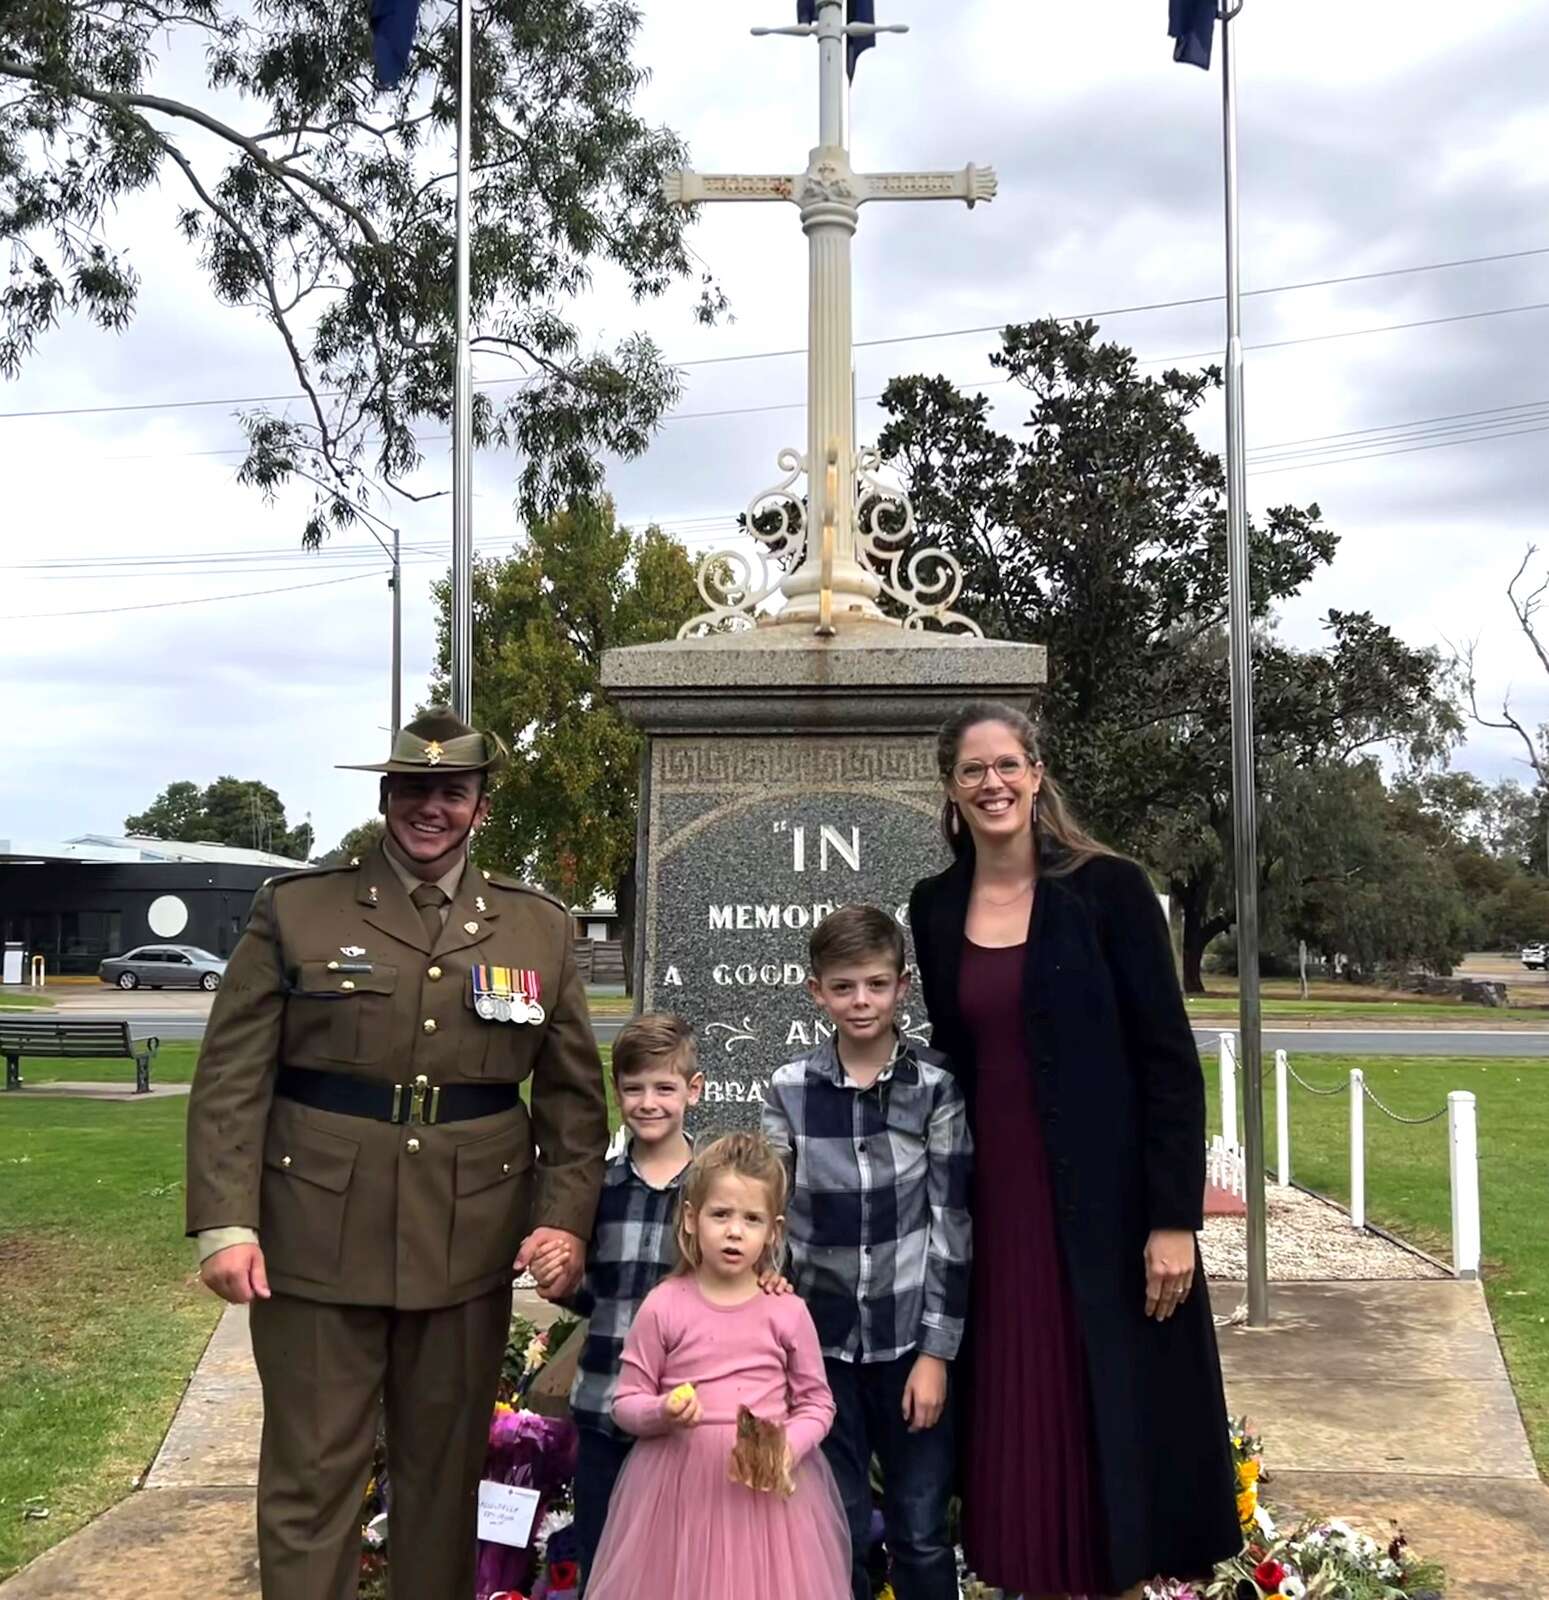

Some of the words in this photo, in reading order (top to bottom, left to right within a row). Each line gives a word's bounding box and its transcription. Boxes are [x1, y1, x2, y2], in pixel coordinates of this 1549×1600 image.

[708, 900, 843, 930] MEMOR
[663, 965, 683, 986] A
[712, 964, 806, 986] GOOD
[785, 1018, 837, 1045] AN
[704, 1079, 770, 1102] BRA
